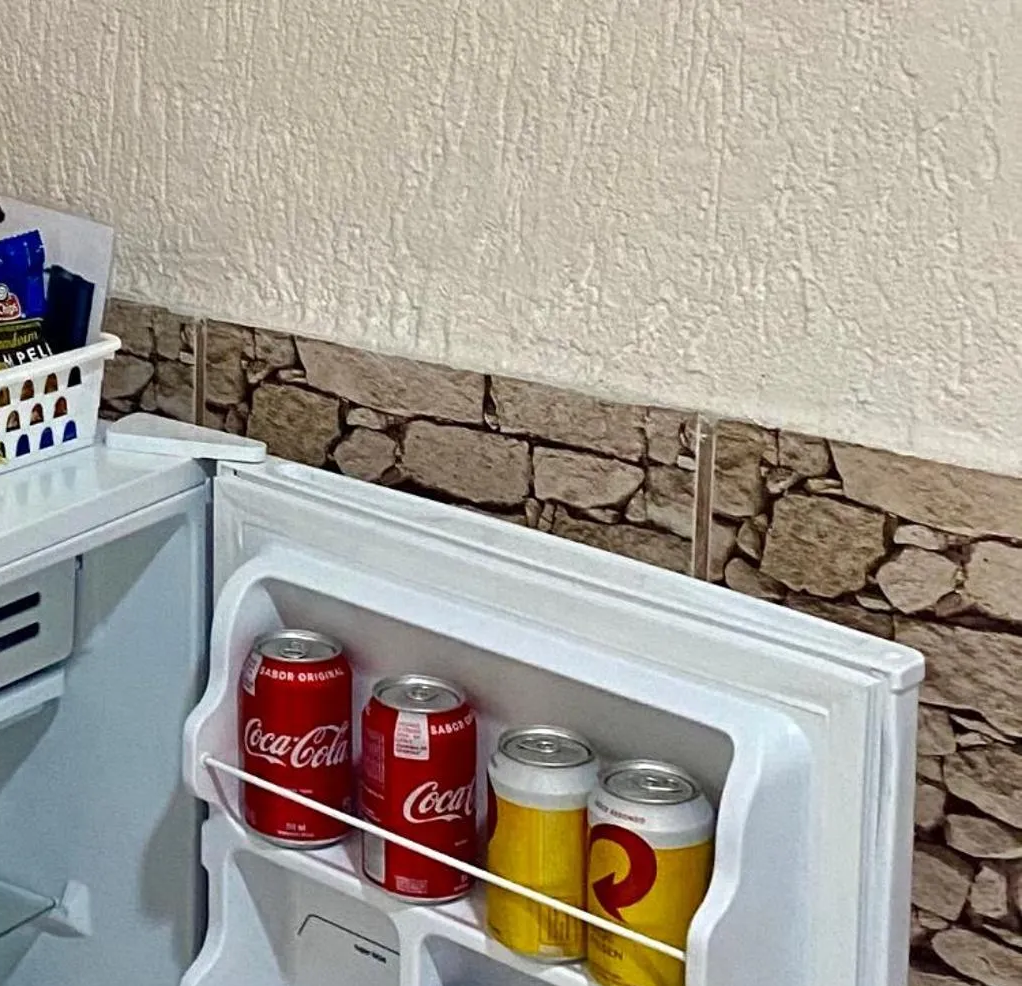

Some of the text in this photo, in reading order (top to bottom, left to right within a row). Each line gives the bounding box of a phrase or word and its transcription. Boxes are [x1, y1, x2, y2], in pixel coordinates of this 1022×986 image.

[259, 665, 345, 682] SABOR ORIGINAL
[431, 718, 465, 735] SABOR
[244, 717, 350, 769] Coca-Cola
